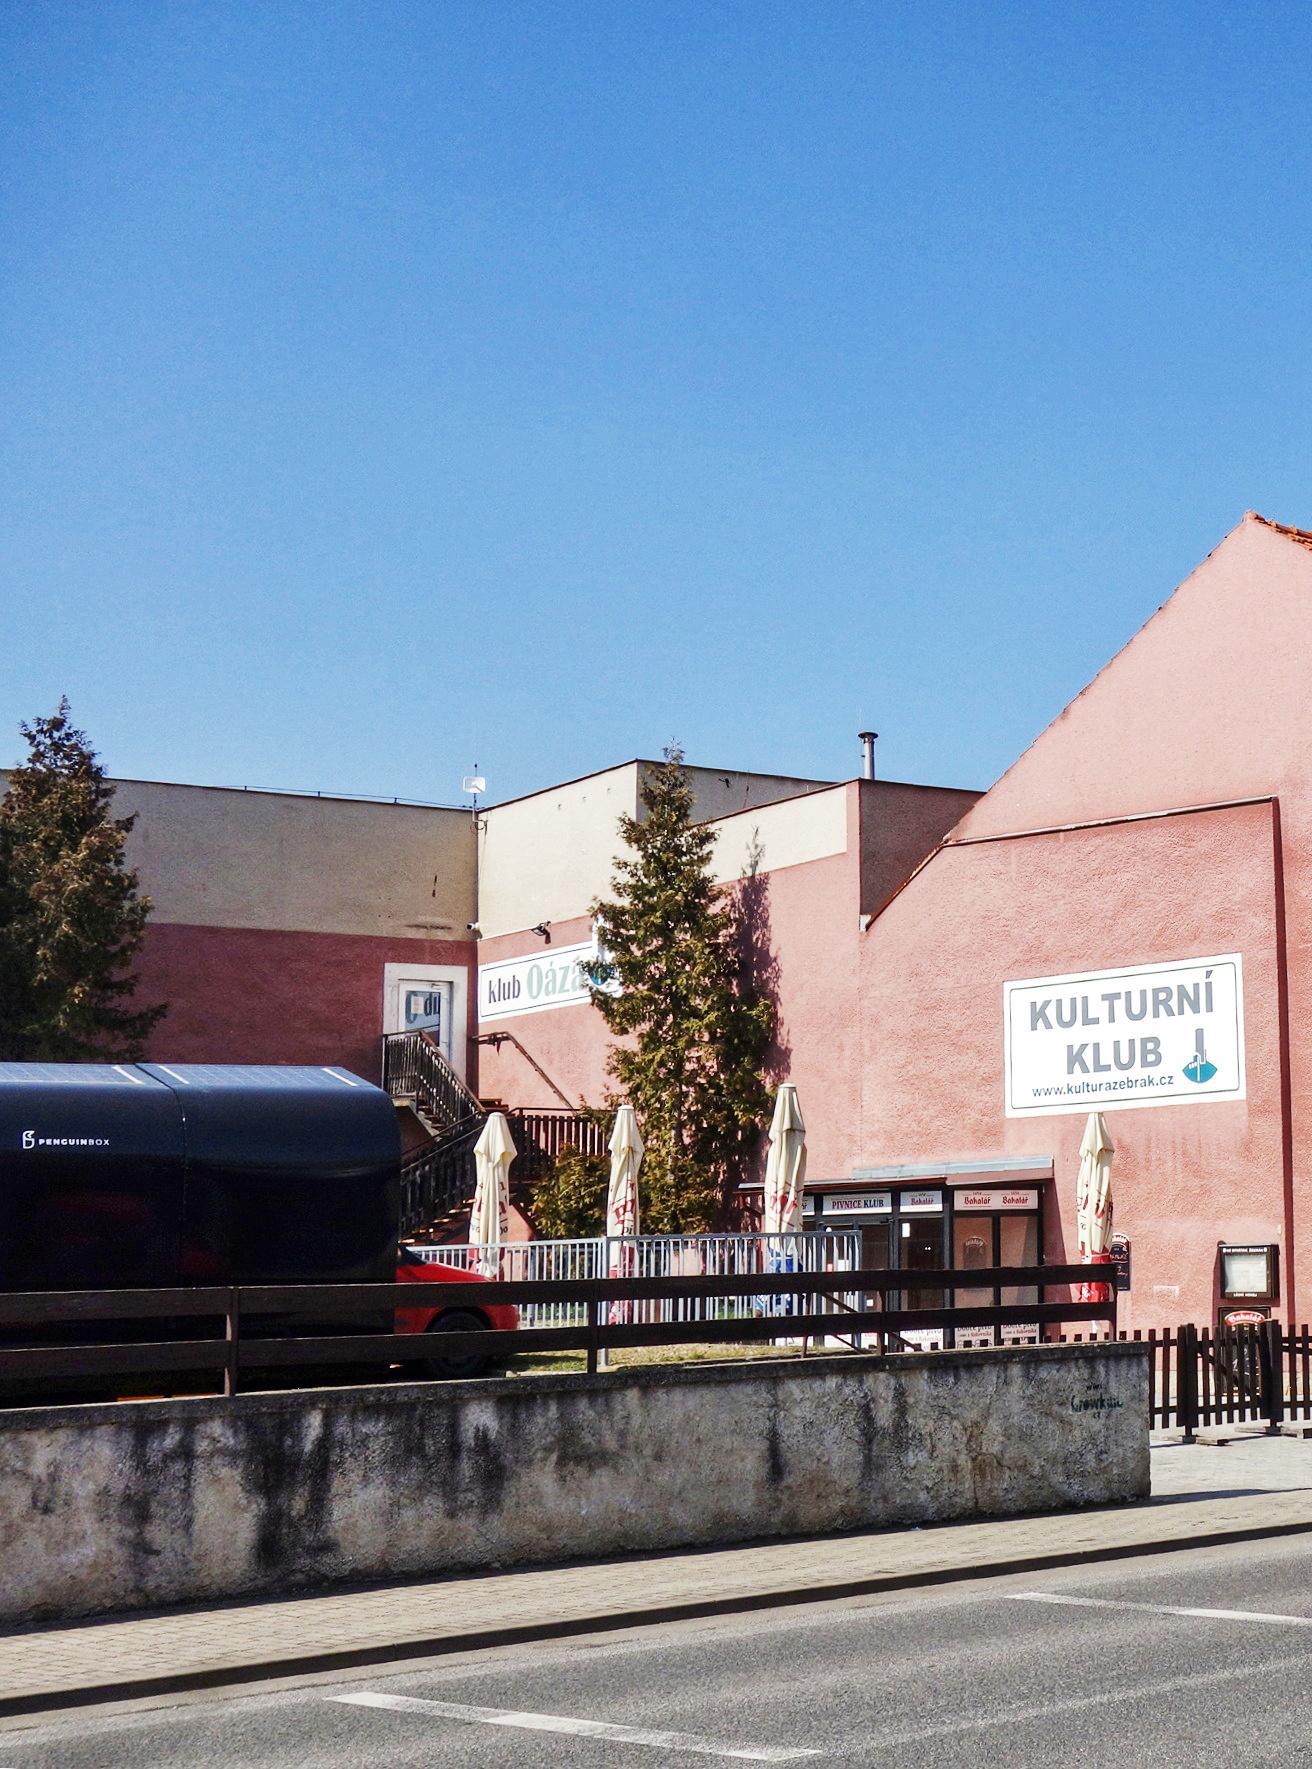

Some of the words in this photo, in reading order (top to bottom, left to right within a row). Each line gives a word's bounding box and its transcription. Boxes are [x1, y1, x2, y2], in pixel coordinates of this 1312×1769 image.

[488, 974, 521, 1004] klub
[1030, 970, 1214, 1031] KULTURNÍ
[1066, 1036, 1163, 1075] KLUB
[1032, 1074, 1174, 1098] www.kulturazebrak.cz
[38, 1138, 110, 1146] PENGUINBOX
[832, 1199, 862, 1210] PIVNICE
[863, 1198, 884, 1208] KLUB
